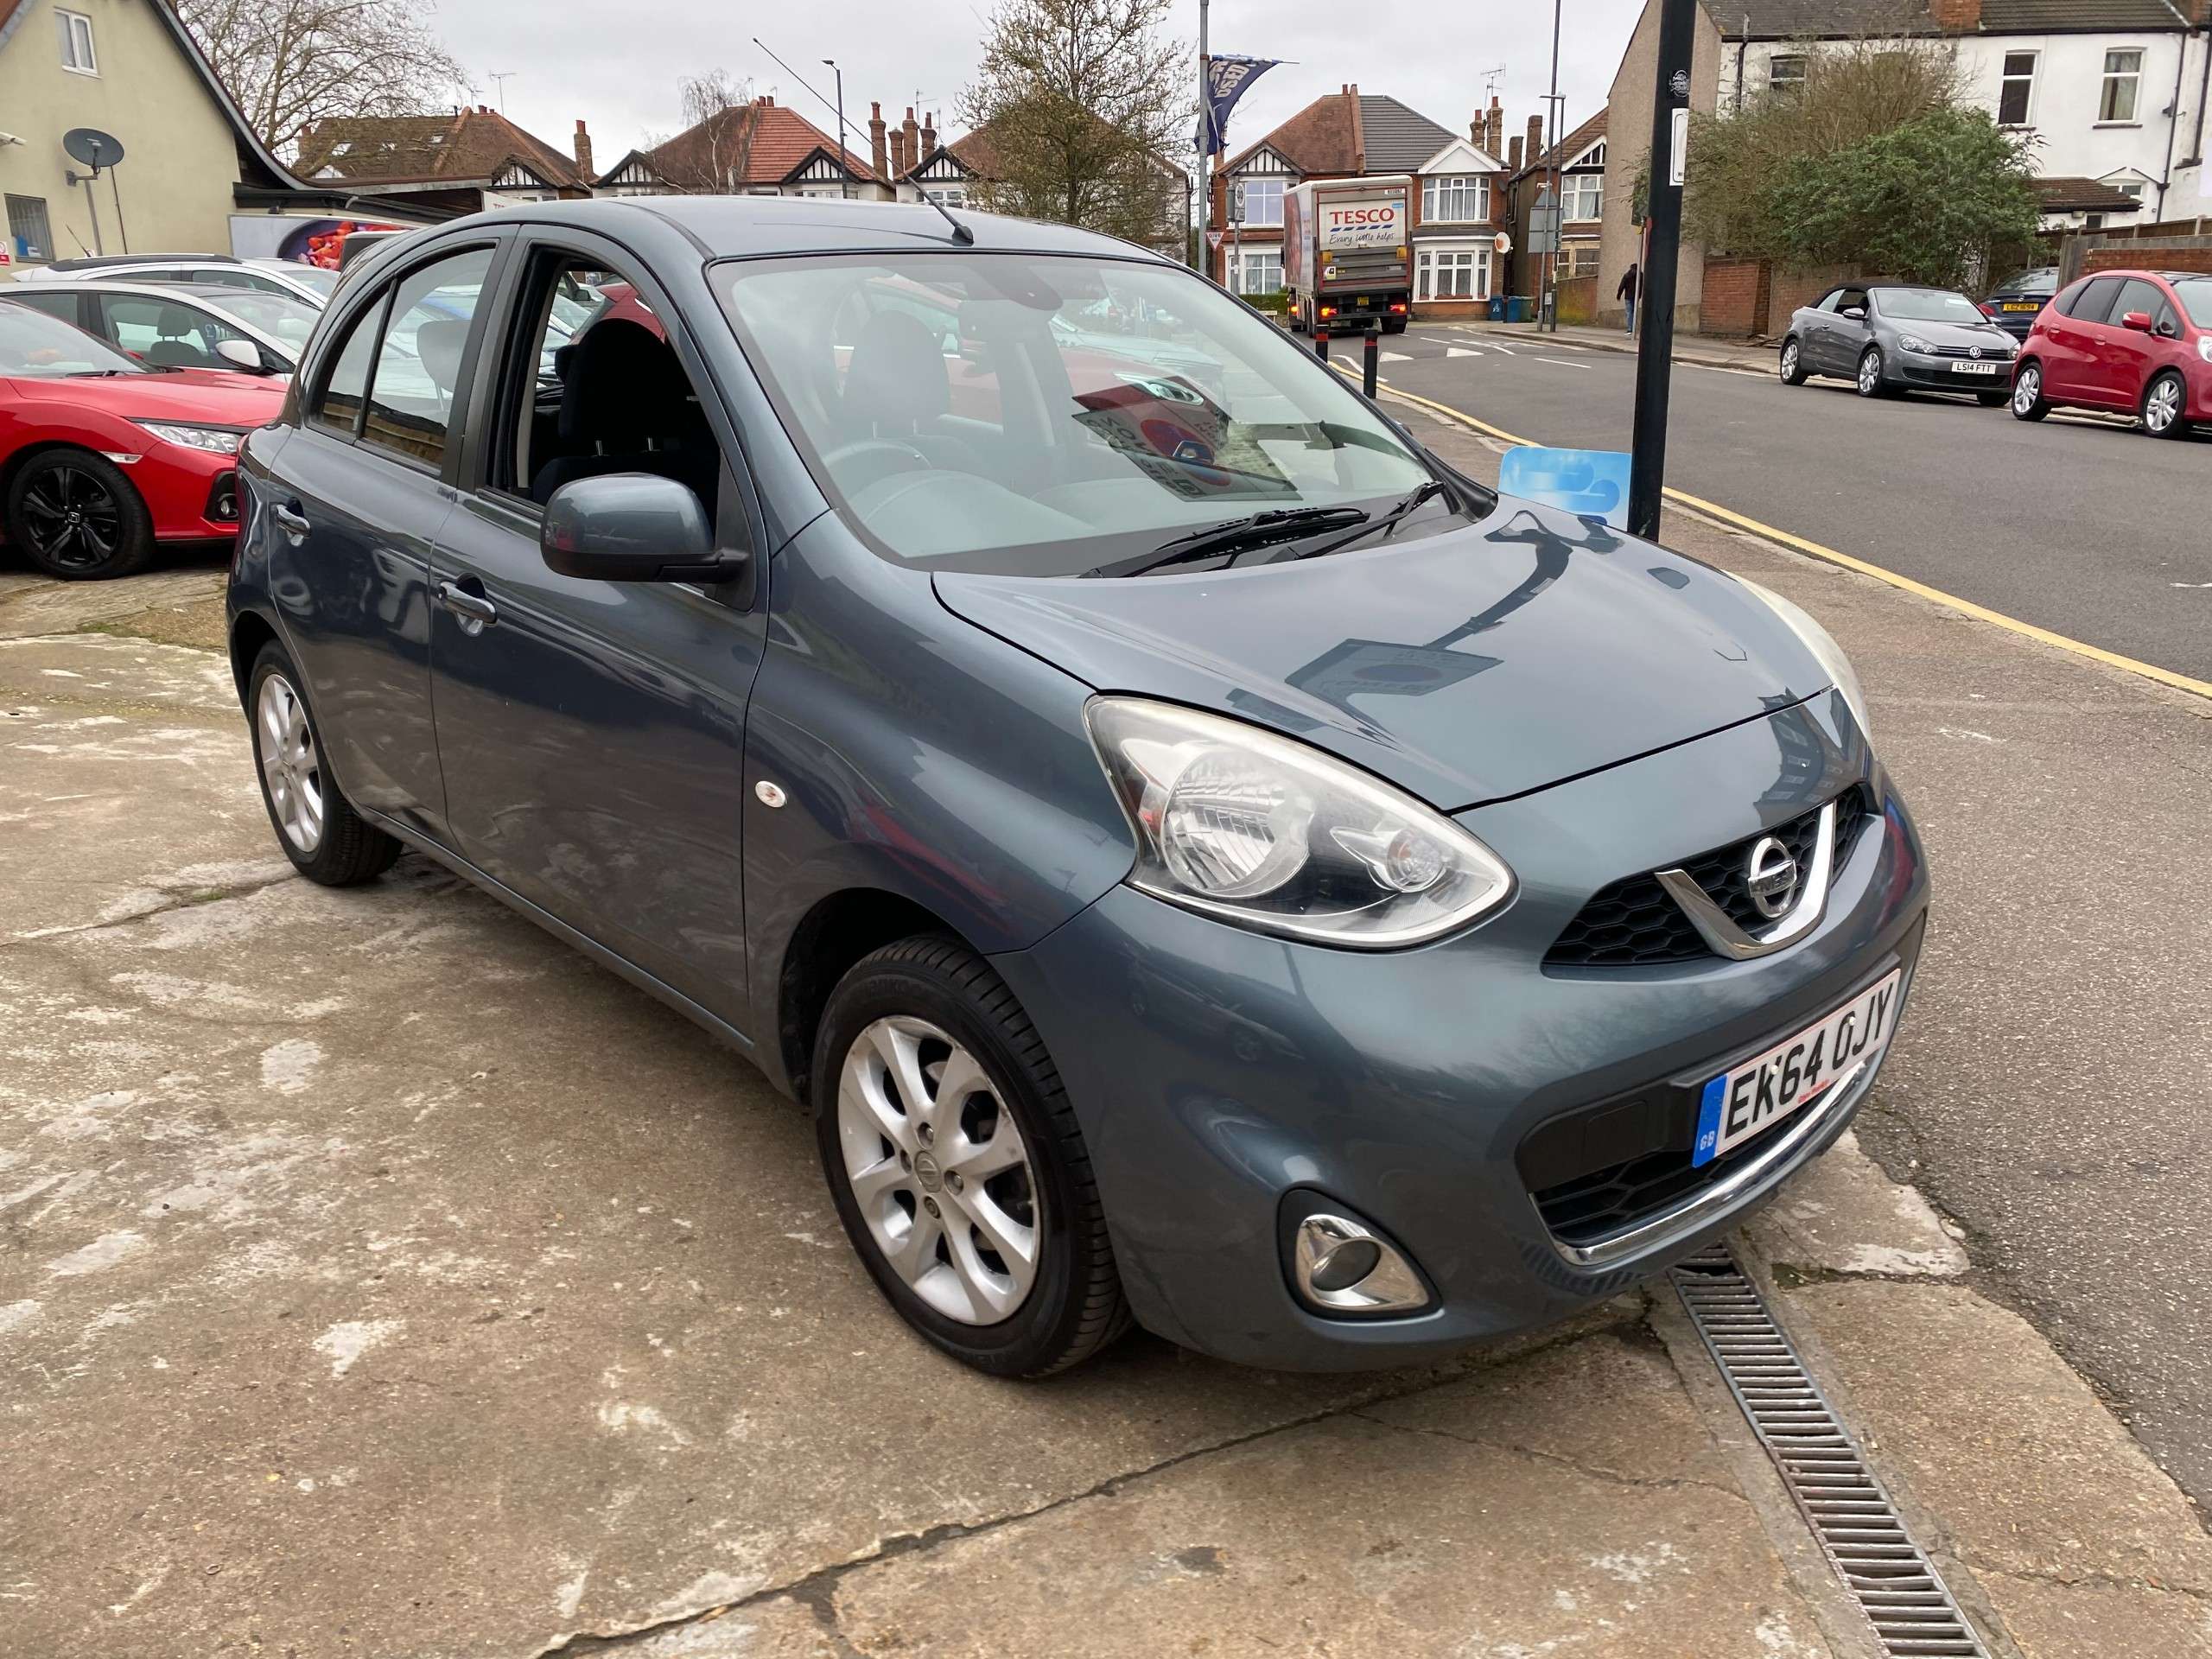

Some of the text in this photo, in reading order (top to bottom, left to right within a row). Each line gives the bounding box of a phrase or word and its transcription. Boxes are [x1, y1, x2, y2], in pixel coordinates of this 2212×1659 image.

[1215, 64, 1249, 98] USED
[1329, 207, 1395, 225] TESCO
[1329, 231, 1395, 246] Every little helps
[1956, 363, 1992, 372] LS14 FTT
[1725, 982, 1894, 1140] EK64 OJY
[1699, 1129, 1716, 1151] GB
